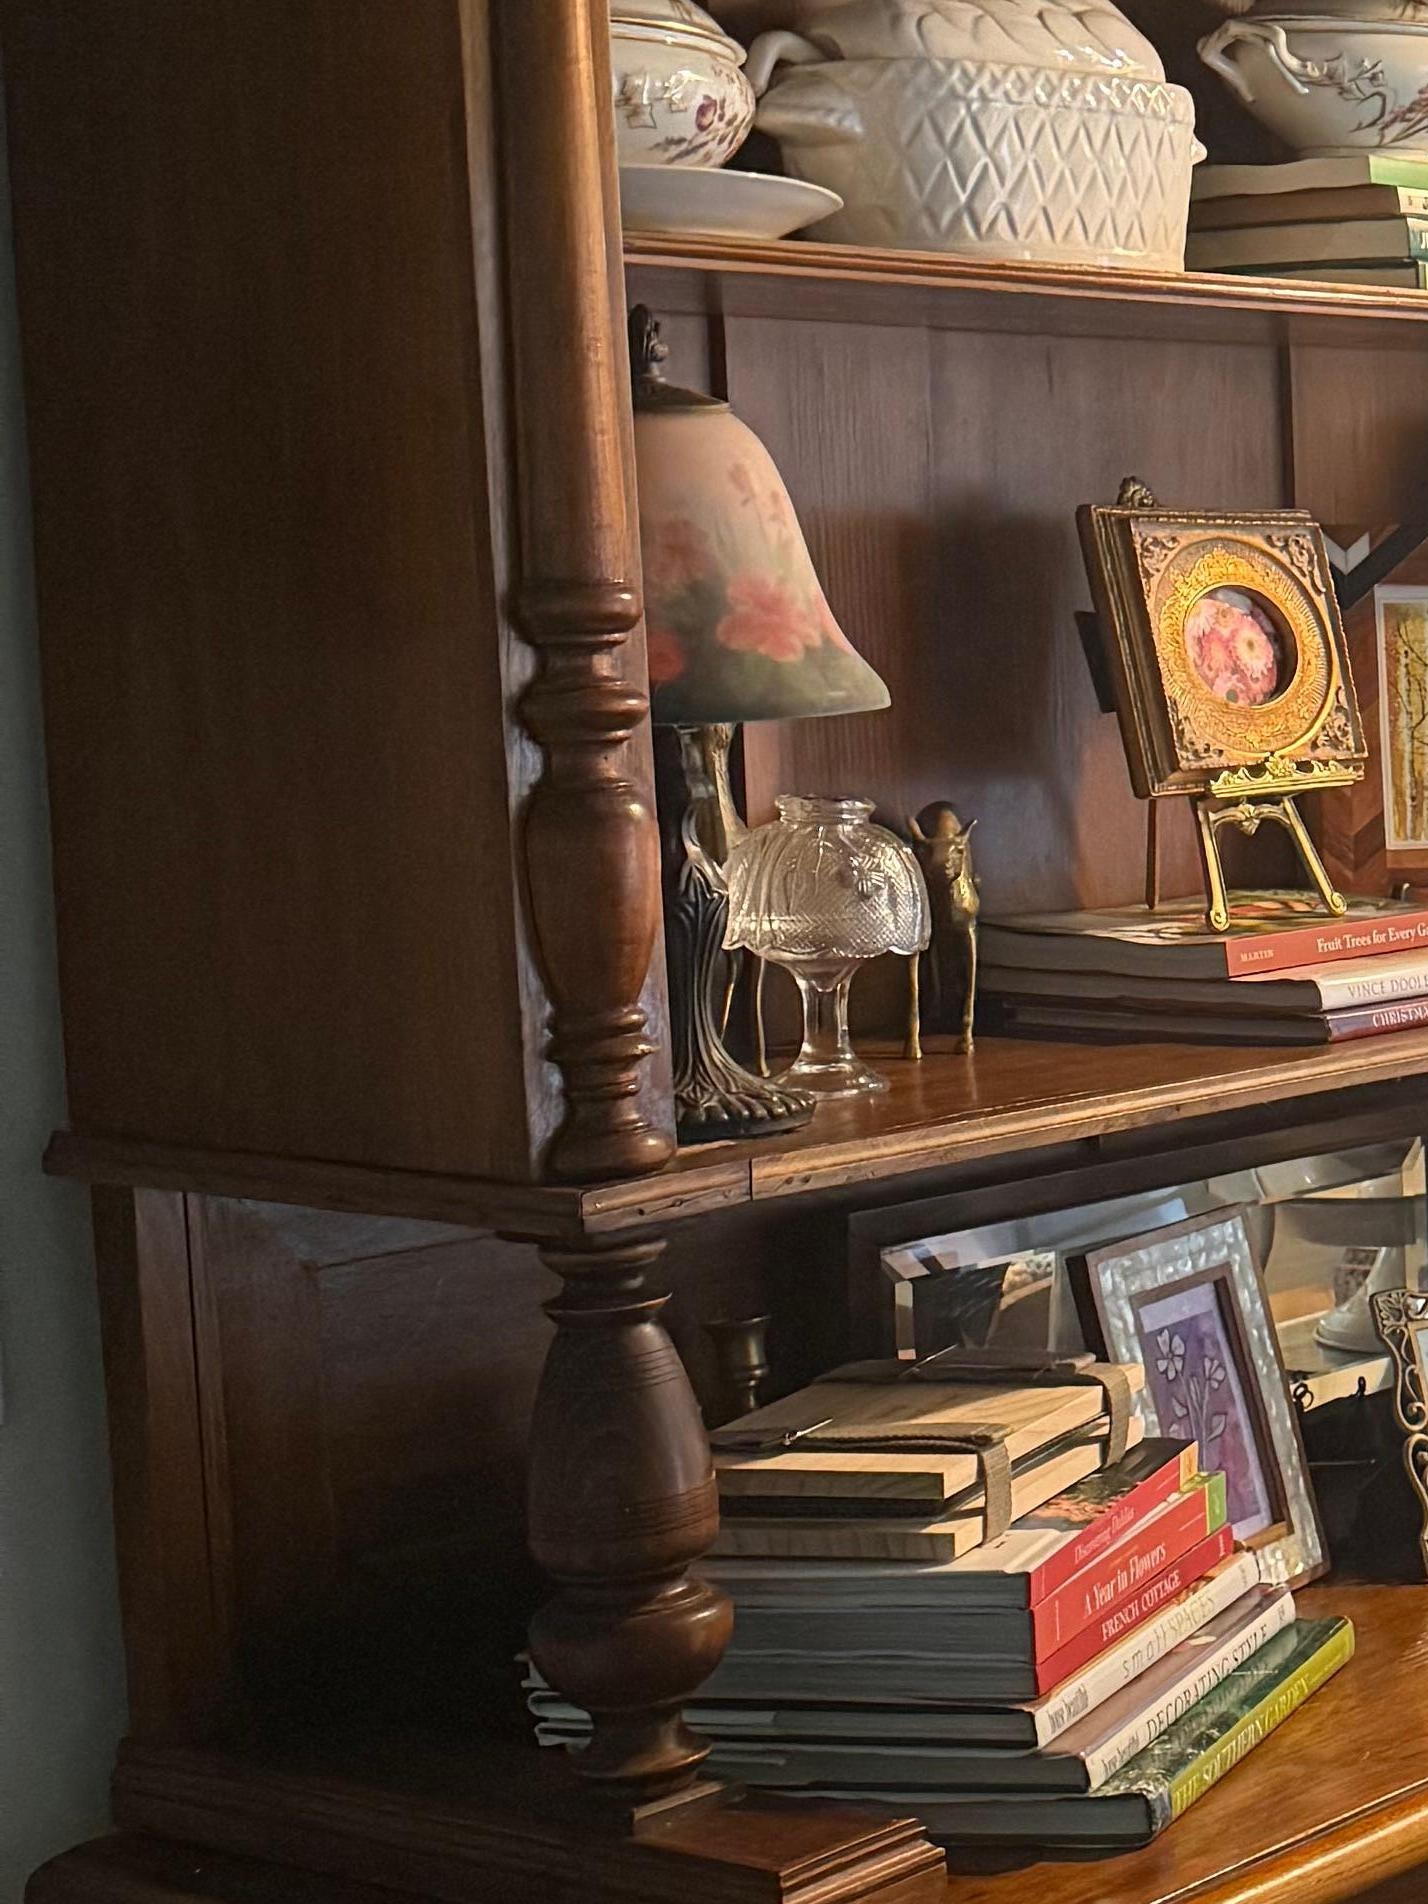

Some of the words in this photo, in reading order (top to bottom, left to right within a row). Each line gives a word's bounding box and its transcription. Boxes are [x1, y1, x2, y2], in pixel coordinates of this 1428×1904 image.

[1240, 949, 1274, 962] MARTIN
[1316, 937, 1343, 953] Fruit
[1343, 934, 1372, 950] Trees
[1372, 930, 1387, 947] for
[1388, 927, 1416, 943] Every
[1347, 983, 1386, 997] VINCE
[1083, 1595, 1091, 1617] A
[1092, 1578, 1115, 1610] Year
[1116, 1569, 1128, 1593] in
[1129, 1542, 1166, 1584] Flowers
[1101, 1603, 1139, 1642] FRENCH
[1141, 1569, 1182, 1612] COTTAGE
[1167, 1594, 1214, 1640] SPACES
[1146, 1658, 1231, 1737] DECORATING
[1231, 1624, 1268, 1663] STYLE
[1203, 1718, 1264, 1782] SOUTHERN
